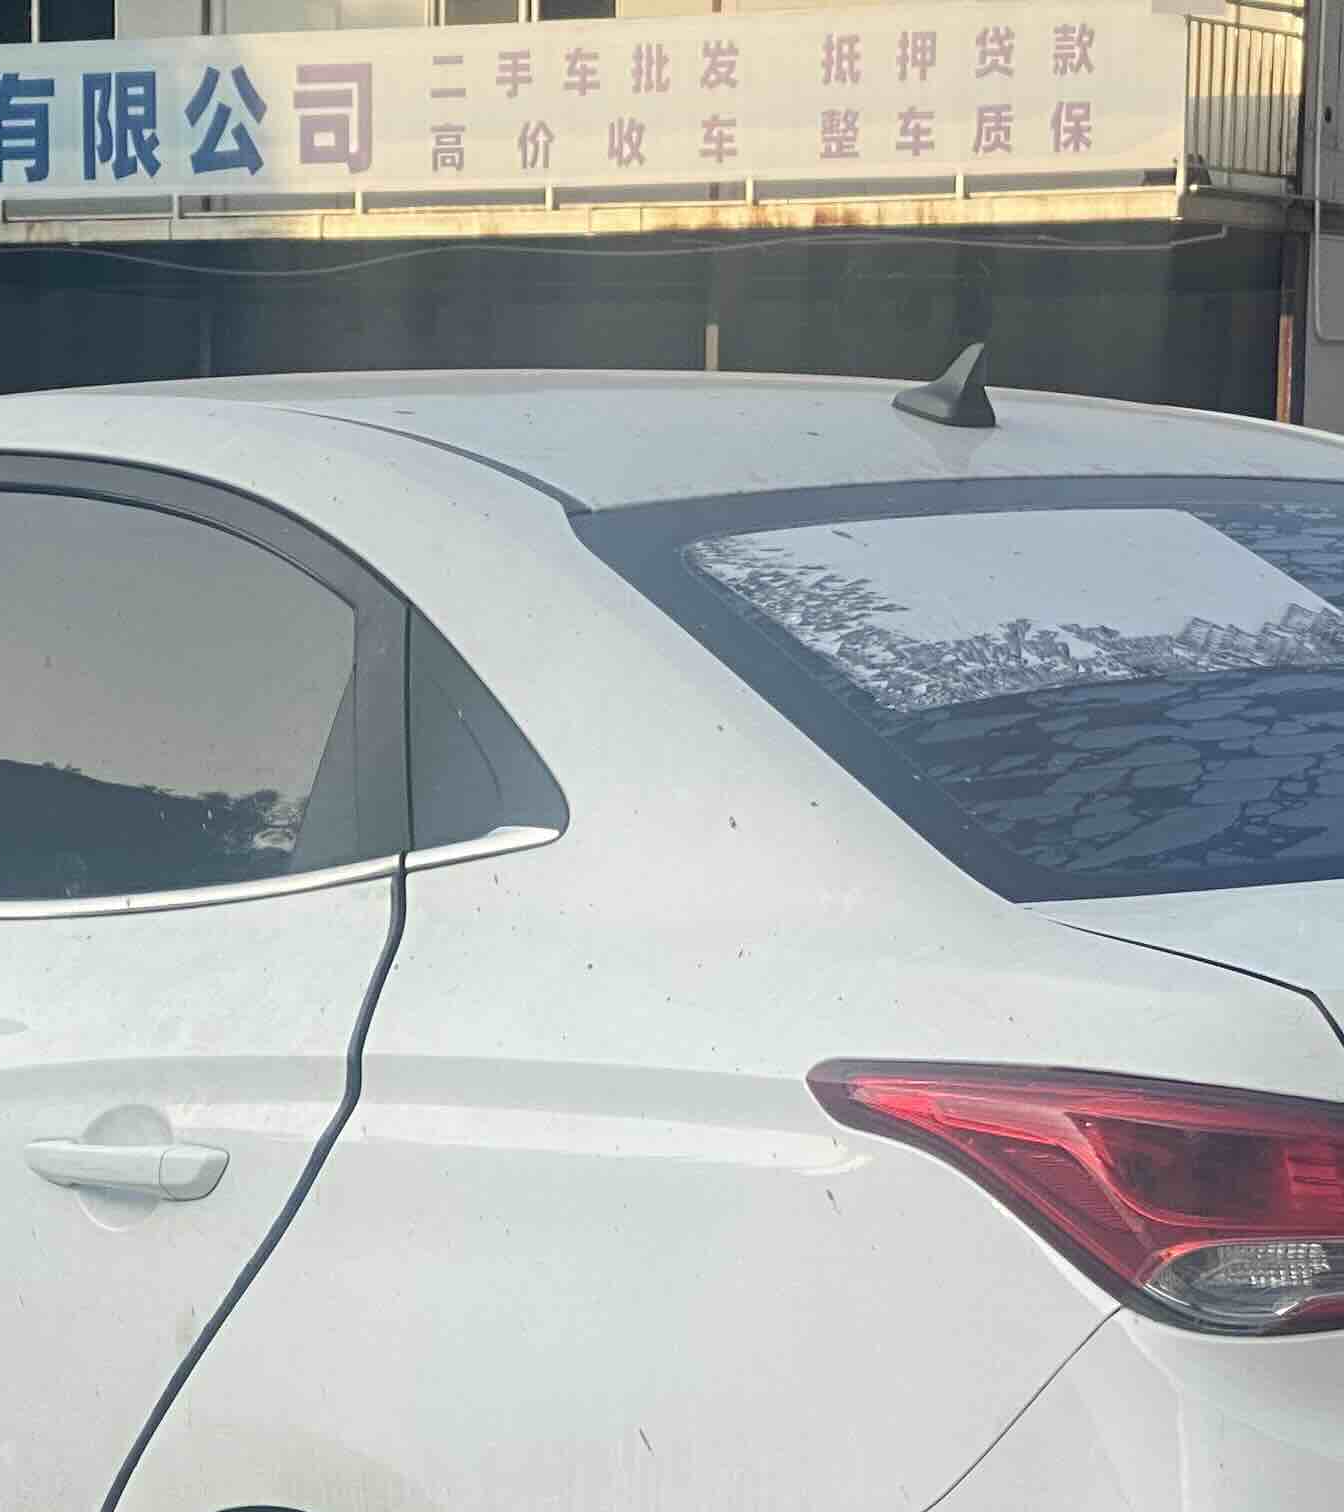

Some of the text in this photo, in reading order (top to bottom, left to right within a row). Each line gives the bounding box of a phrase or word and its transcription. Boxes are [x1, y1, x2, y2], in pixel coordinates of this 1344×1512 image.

[429, 23, 1095, 99] 二手车批发 抵押贷款
[429, 101, 1093, 173] 高价收车 整车质保
